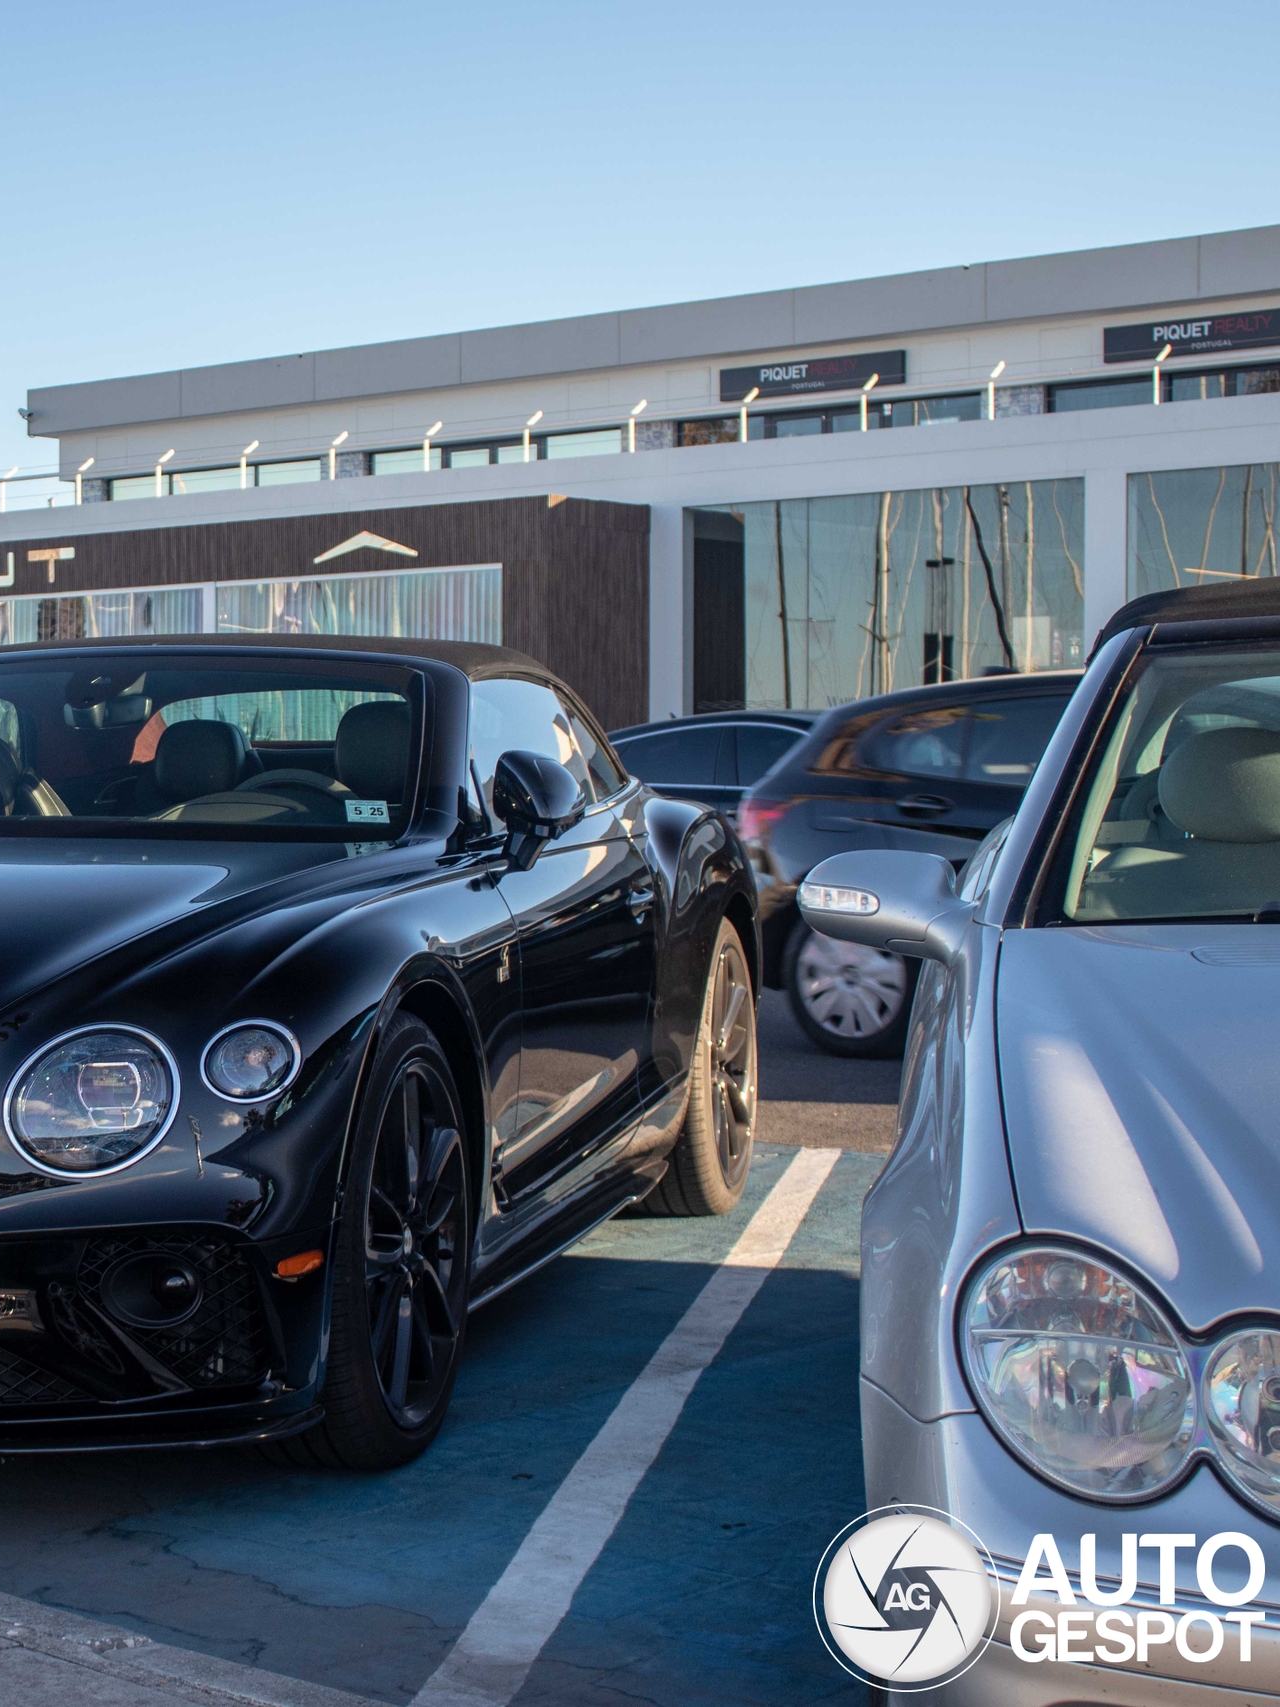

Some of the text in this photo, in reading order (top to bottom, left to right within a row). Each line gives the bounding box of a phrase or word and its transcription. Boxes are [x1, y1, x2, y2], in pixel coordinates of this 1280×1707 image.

[1153, 314, 1272, 342] PIQUET REALTY
[1191, 339, 1233, 350] PORTUGAL
[760, 358, 858, 383] PIQUET REALTY
[791, 381, 825, 390] PORTUGAL
[354, 806, 384, 816] 5 25
